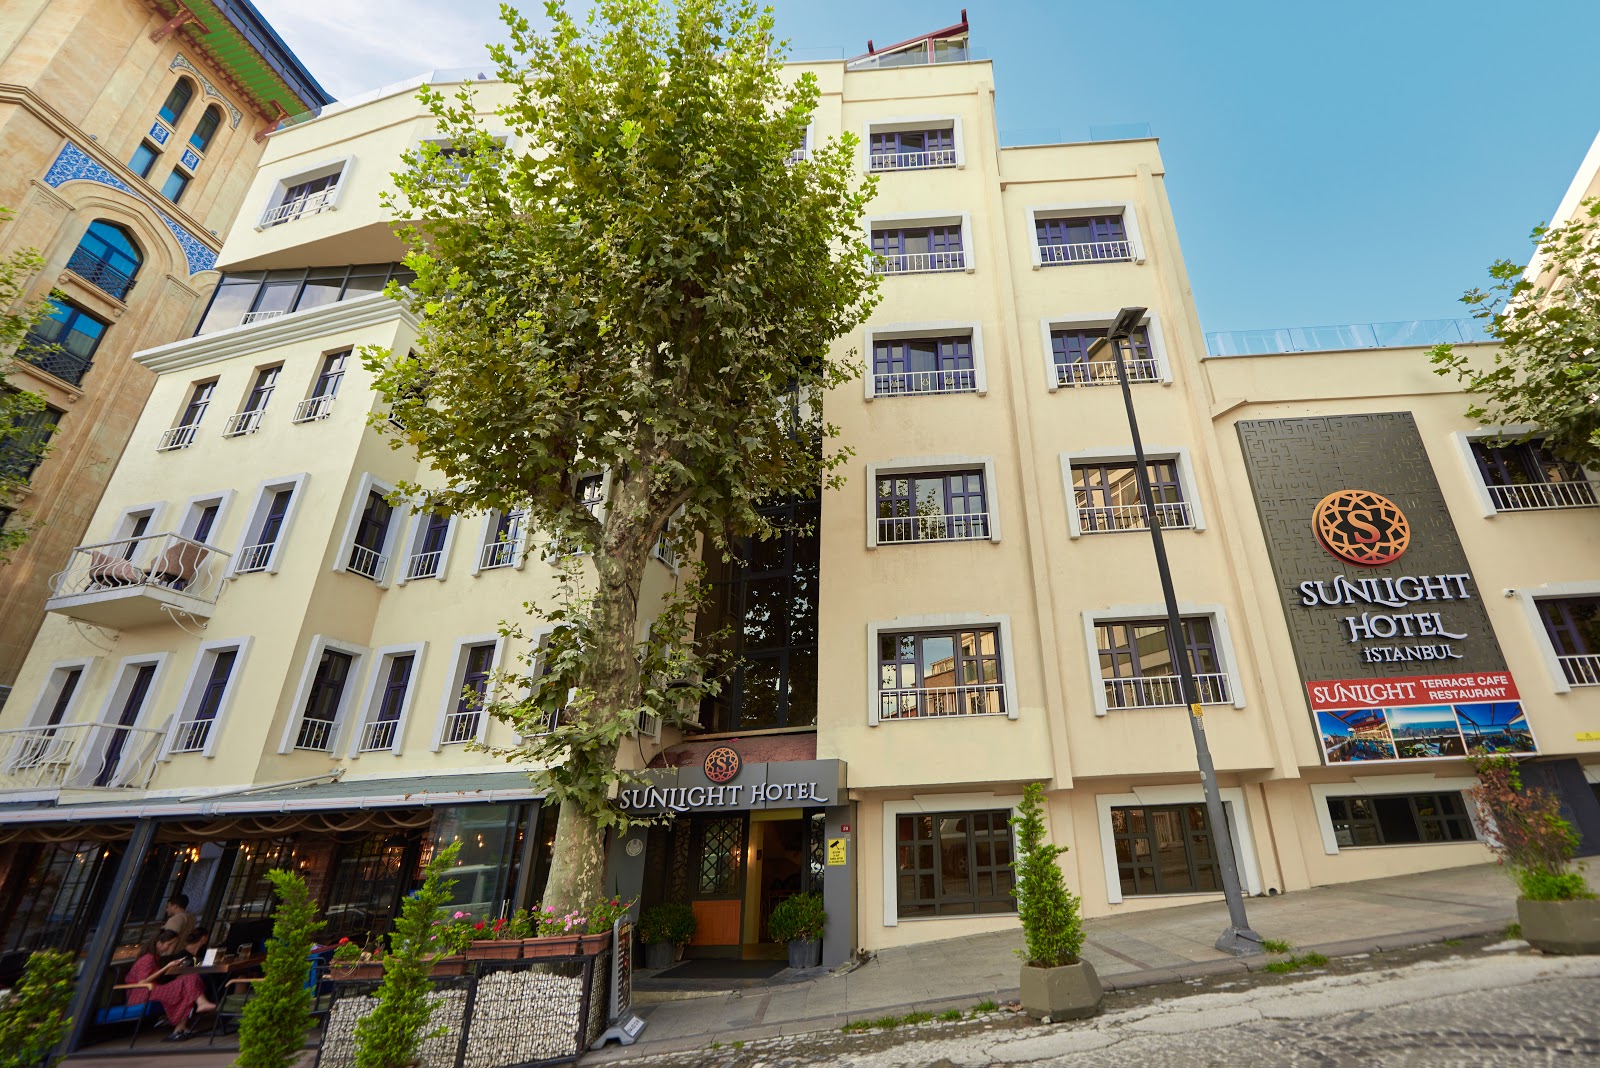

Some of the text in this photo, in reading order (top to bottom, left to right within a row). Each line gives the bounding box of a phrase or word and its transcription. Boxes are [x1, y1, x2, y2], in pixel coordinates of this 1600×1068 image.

[1347, 510, 1380, 543] S
[1300, 573, 1471, 607] SUNLIGHT
[1345, 612, 1468, 643] HOTEL
[1313, 682, 1416, 705] SUNLIGHT
[1420, 675, 1509, 689] TERRACE CAFE
[1428, 688, 1507, 700] RESTAURANT
[716, 757, 728, 772] S
[619, 782, 828, 811] SUNLIGHT HOTEL
